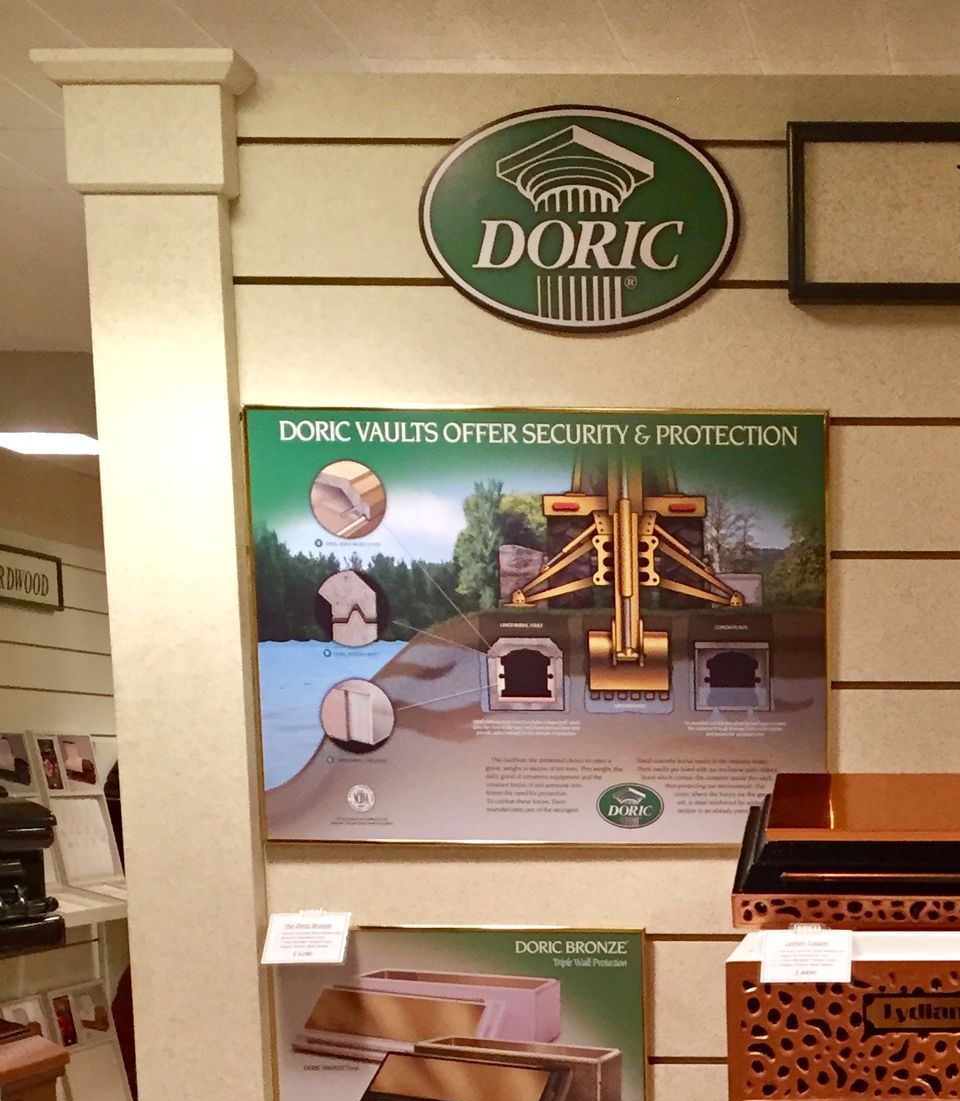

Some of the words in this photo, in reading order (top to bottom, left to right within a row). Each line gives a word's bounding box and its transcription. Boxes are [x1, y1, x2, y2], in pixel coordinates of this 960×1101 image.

[472, 219, 685, 270] DORIC
[279, 420, 352, 442] DORIC
[355, 421, 439, 443] VAULTS
[443, 422, 518, 444] OFFER
[522, 423, 629, 445] SECURITY
[634, 424, 651, 445] &
[656, 425, 798, 446] PROTECTION
[608, 804, 653, 817] DORIC
[515, 940, 563, 954] DORIC
[565, 940, 628, 954] BRONZE
[552, 958, 573, 968] Triple
[574, 958, 592, 967] Wall
[592, 958, 627, 967] Protection
